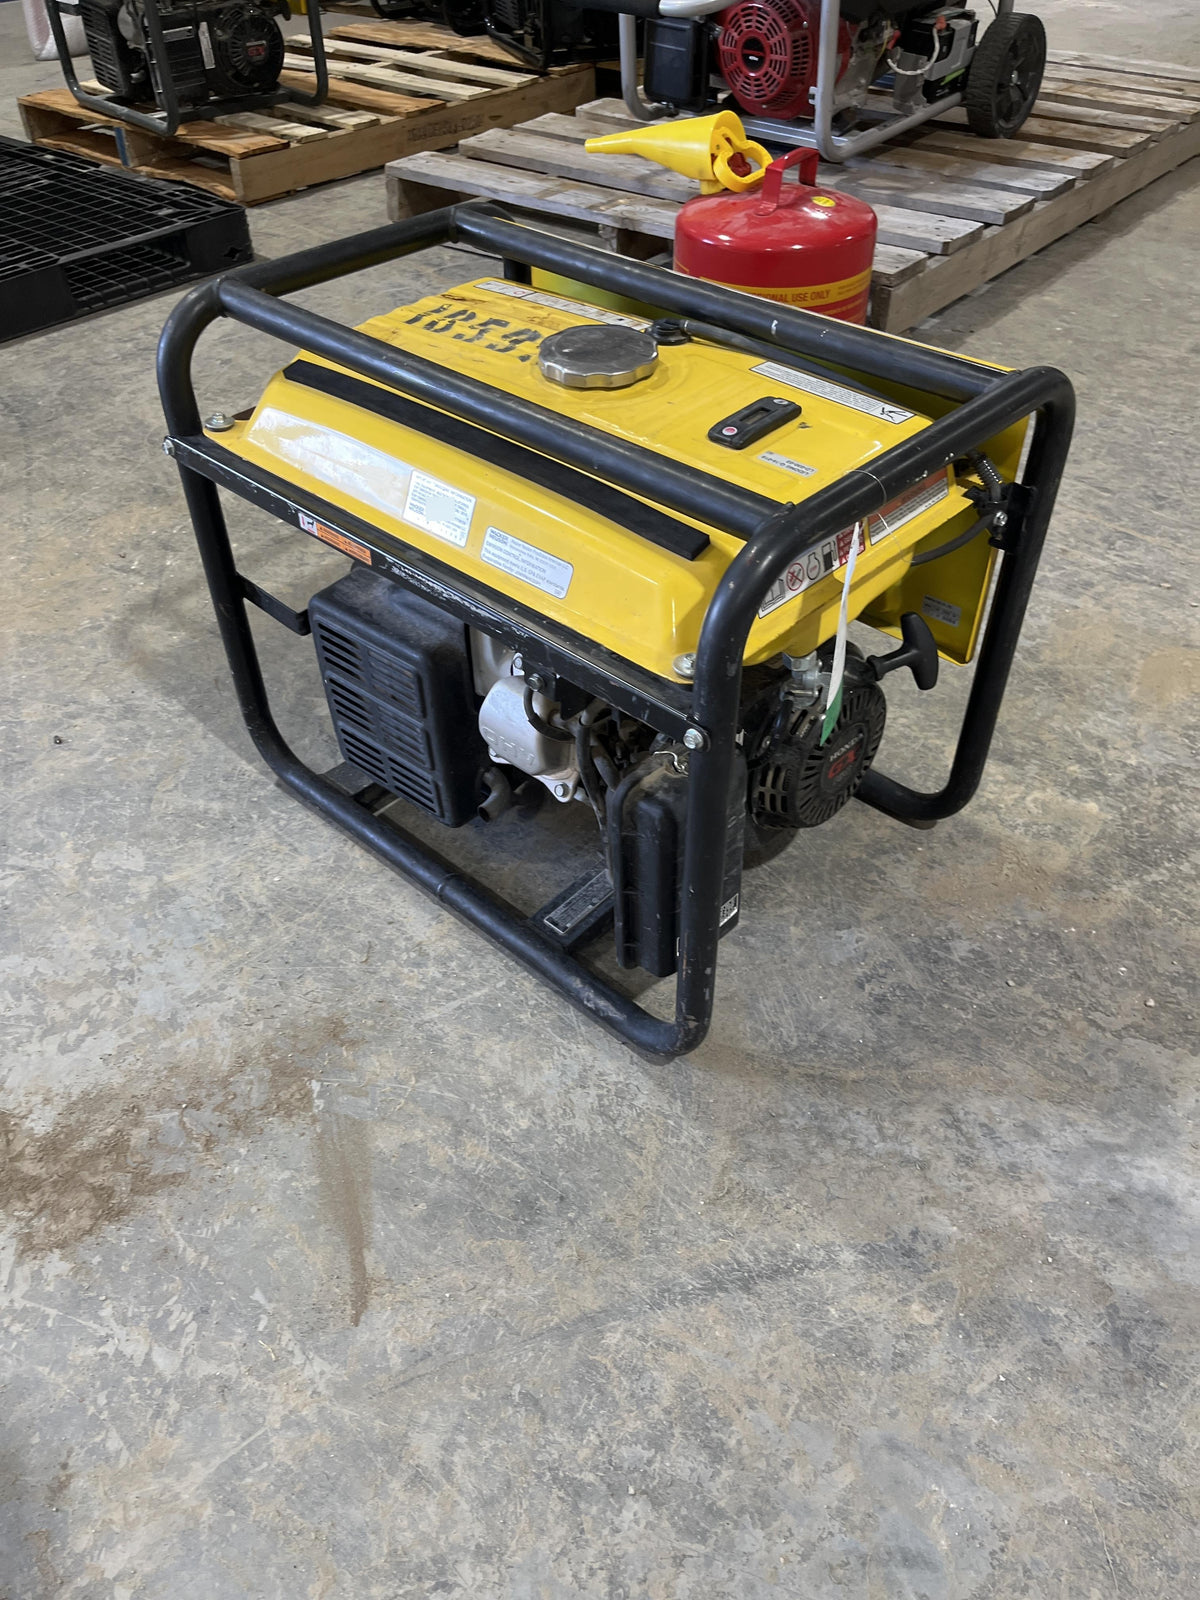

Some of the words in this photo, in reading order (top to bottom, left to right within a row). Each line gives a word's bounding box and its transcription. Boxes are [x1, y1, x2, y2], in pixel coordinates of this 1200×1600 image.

[792, 292, 808, 302] USE
[810, 289, 830, 300] ONLY
[830, 733, 864, 762] HONDA
